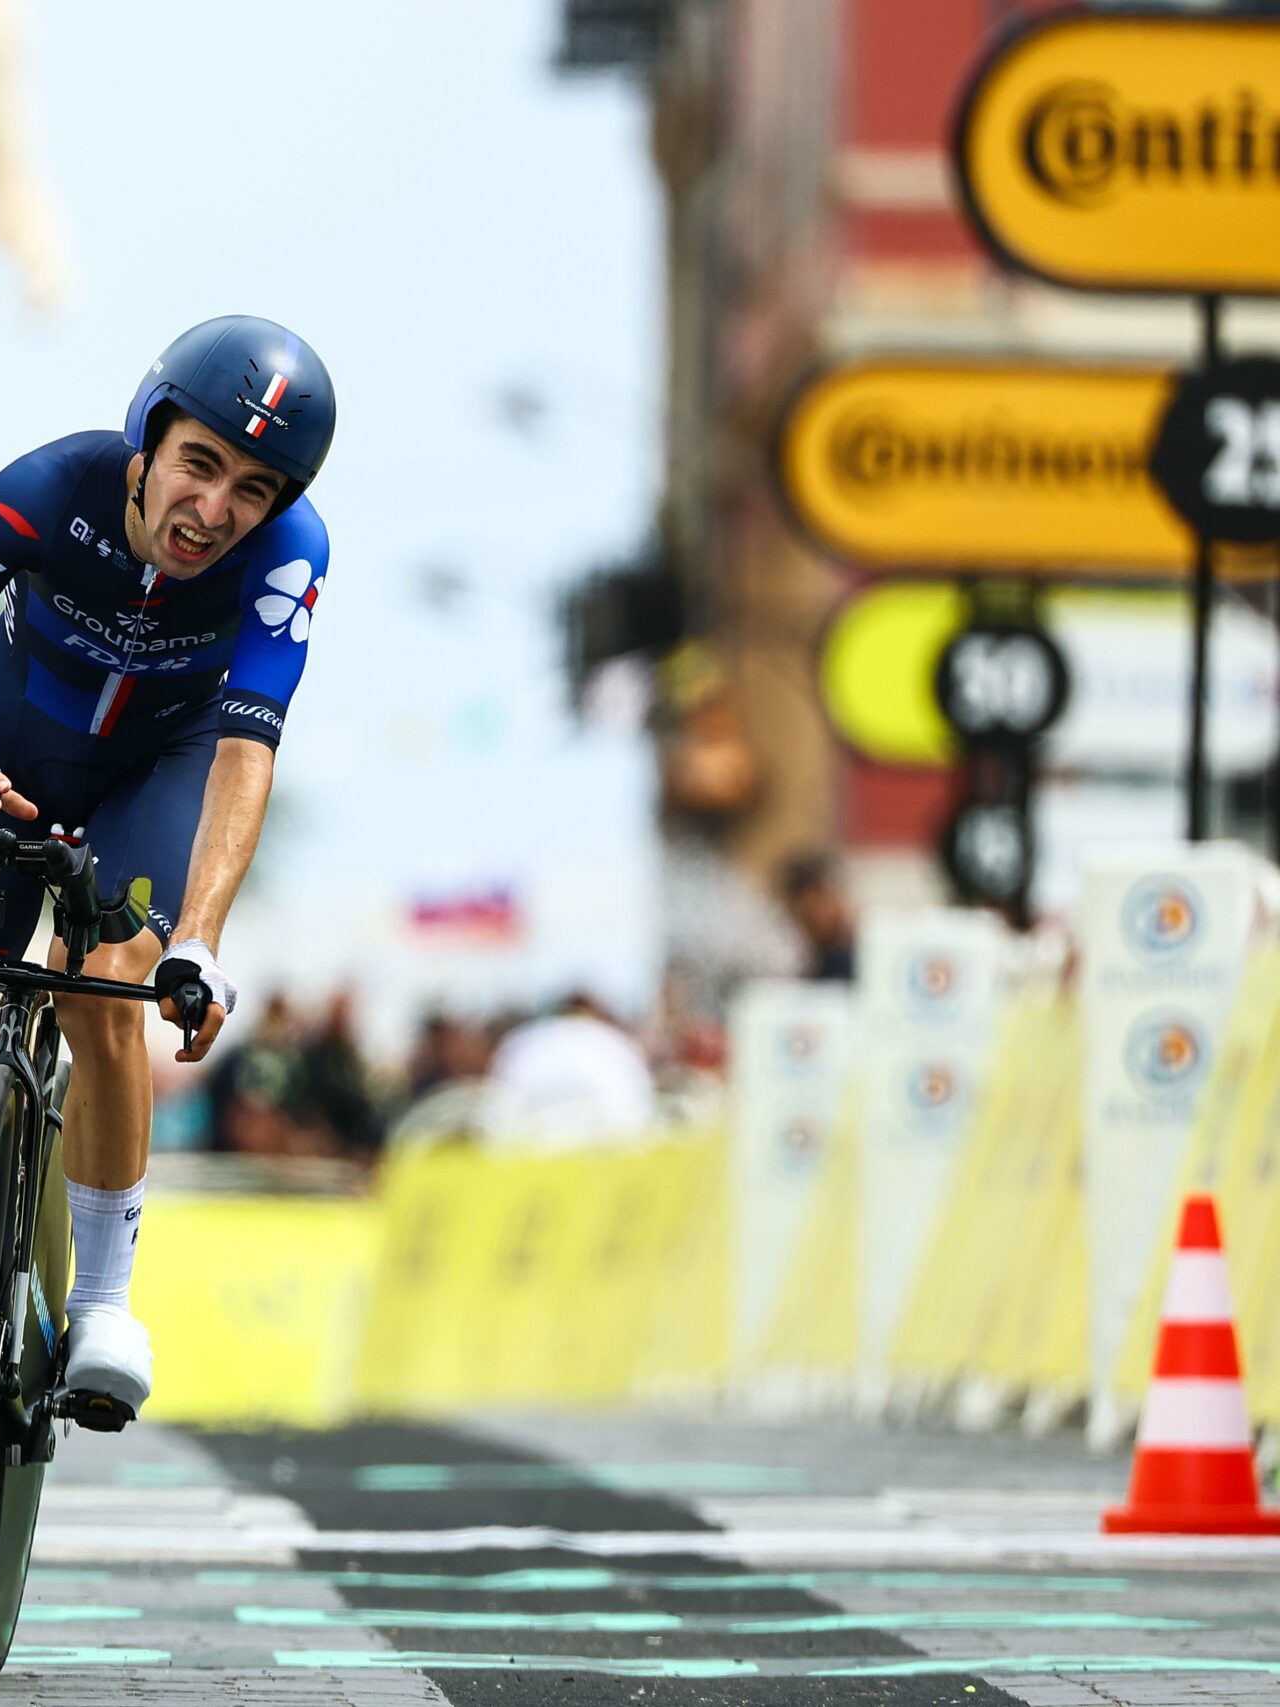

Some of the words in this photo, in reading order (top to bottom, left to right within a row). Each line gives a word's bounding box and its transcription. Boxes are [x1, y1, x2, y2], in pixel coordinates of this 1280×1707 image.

[1018, 80, 1280, 210] Conti
[52, 593, 217, 654] Groupama
[63, 633, 150, 672] FDJ
